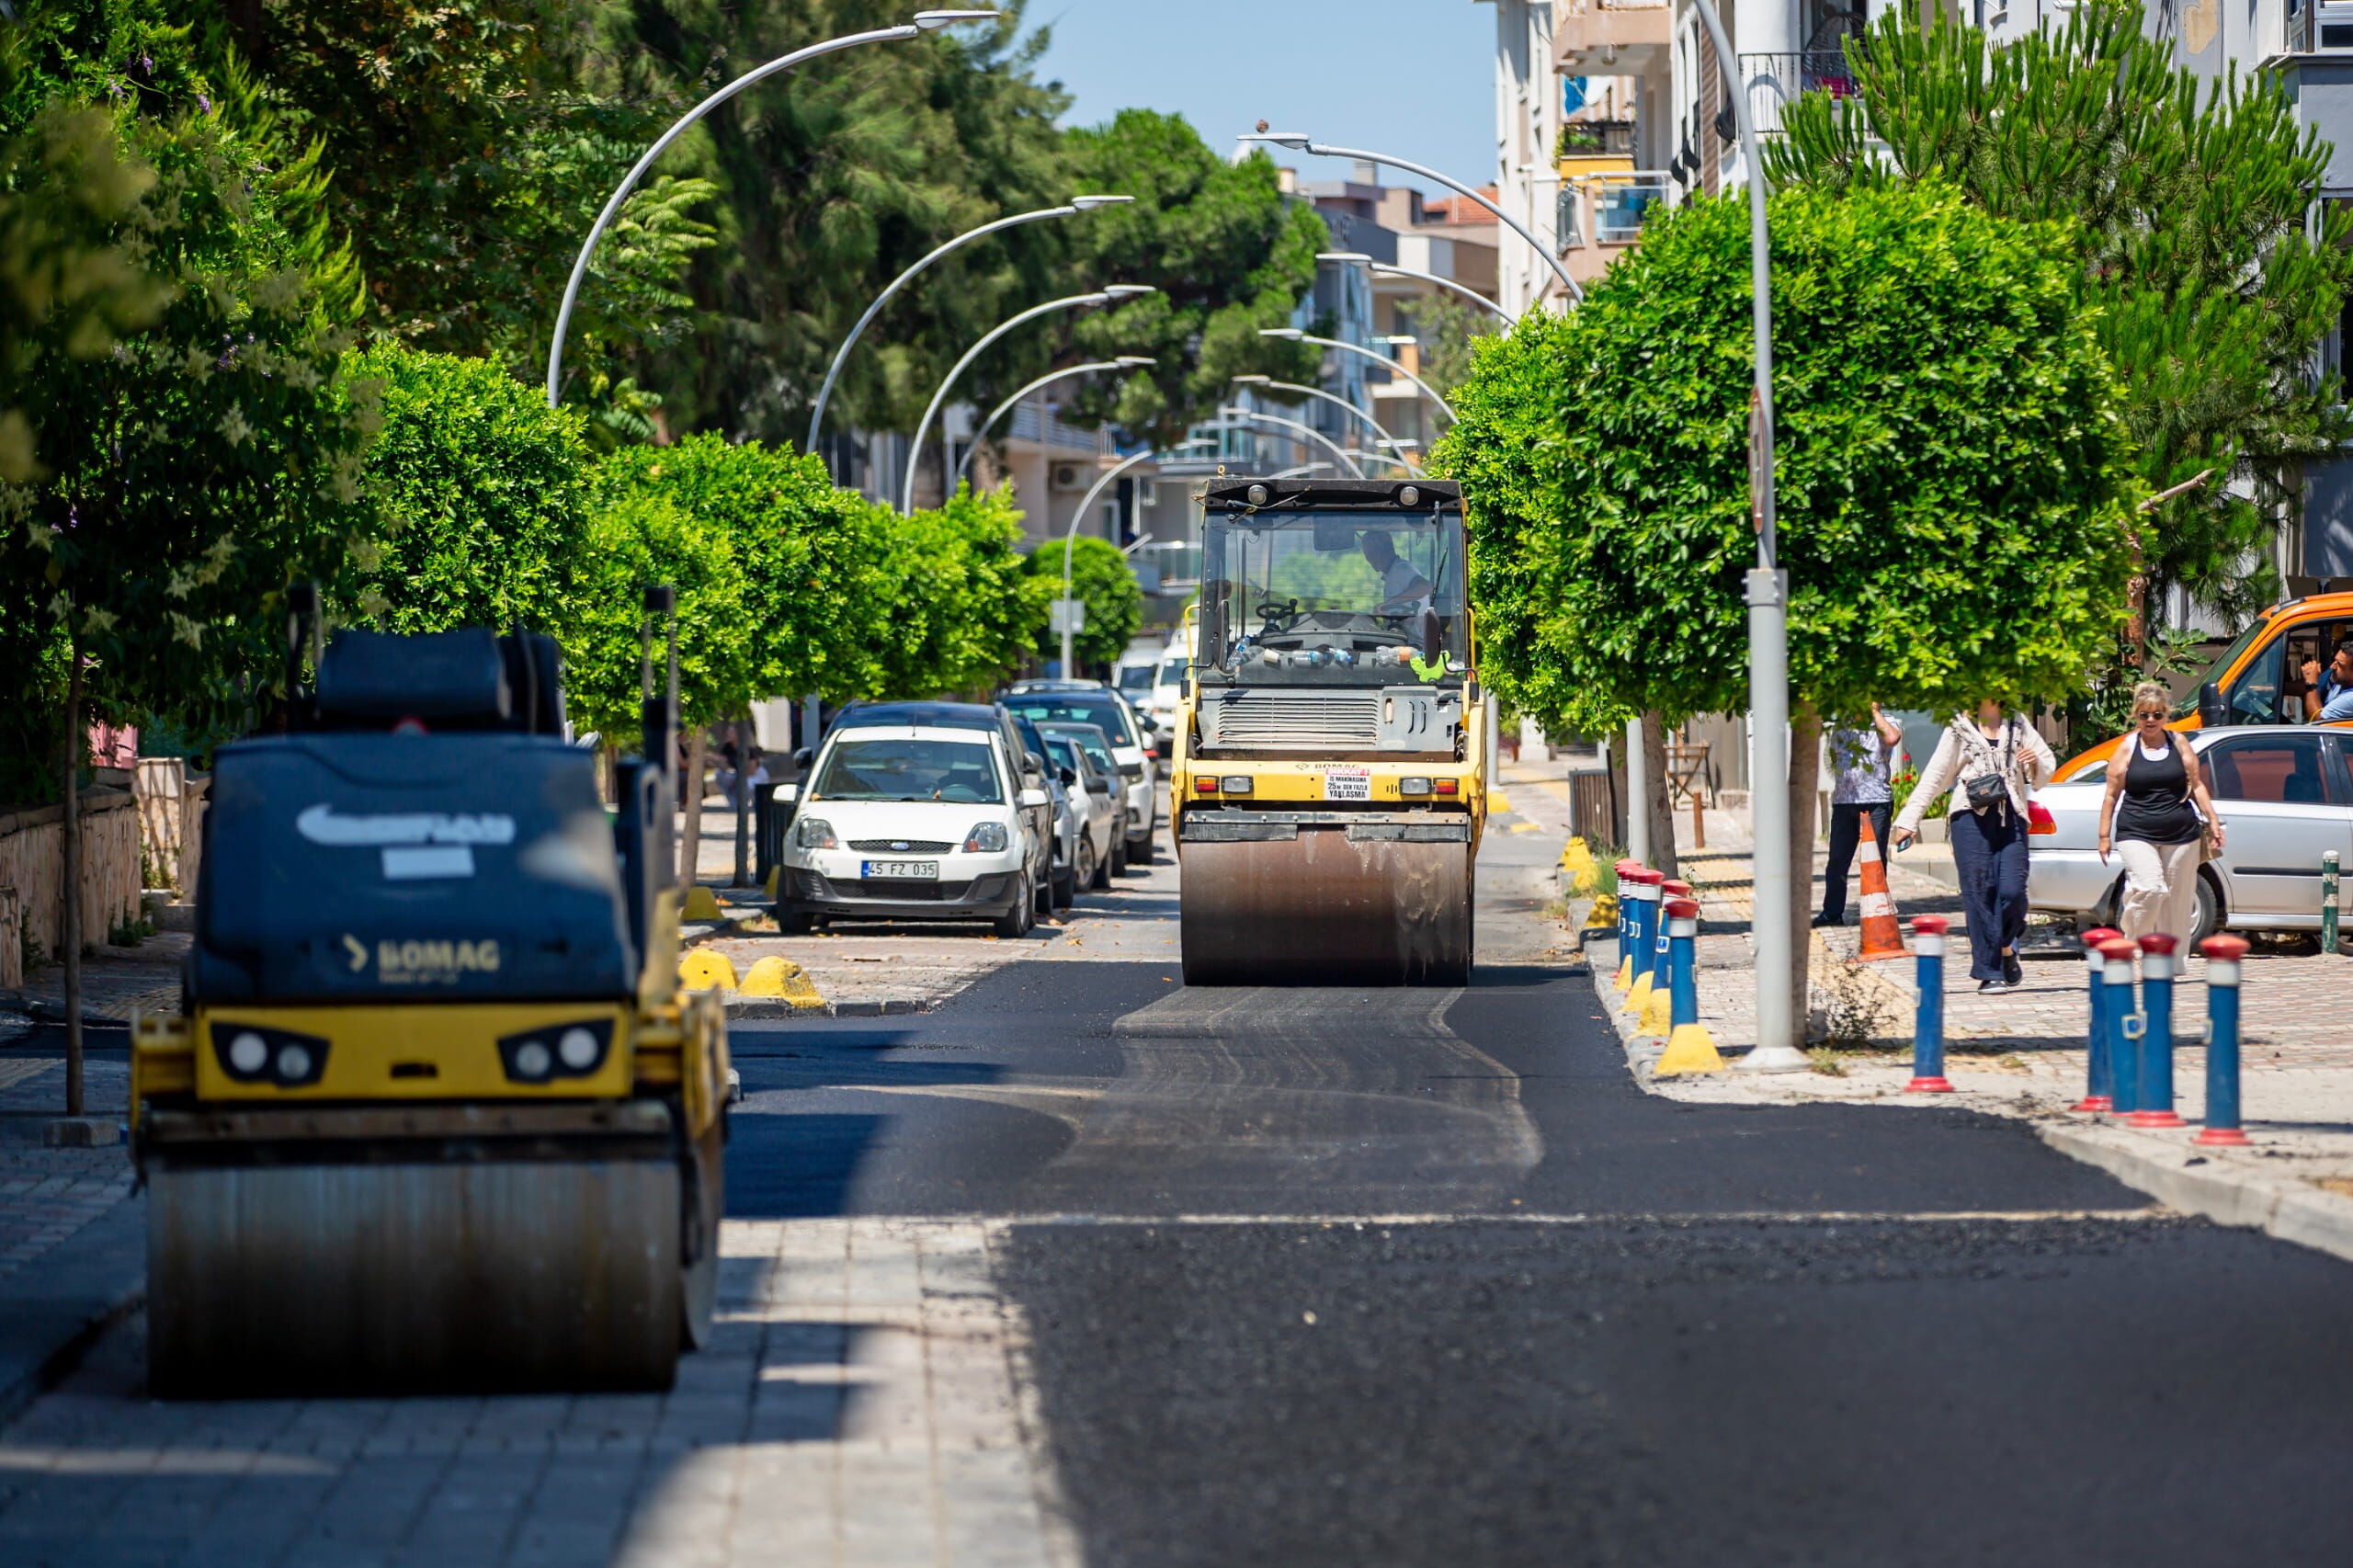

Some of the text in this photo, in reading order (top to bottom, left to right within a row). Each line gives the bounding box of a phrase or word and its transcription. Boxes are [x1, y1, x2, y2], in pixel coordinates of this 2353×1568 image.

[869, 863, 935, 876] 45 FZ 035
[378, 940, 499, 971] BOMAG
